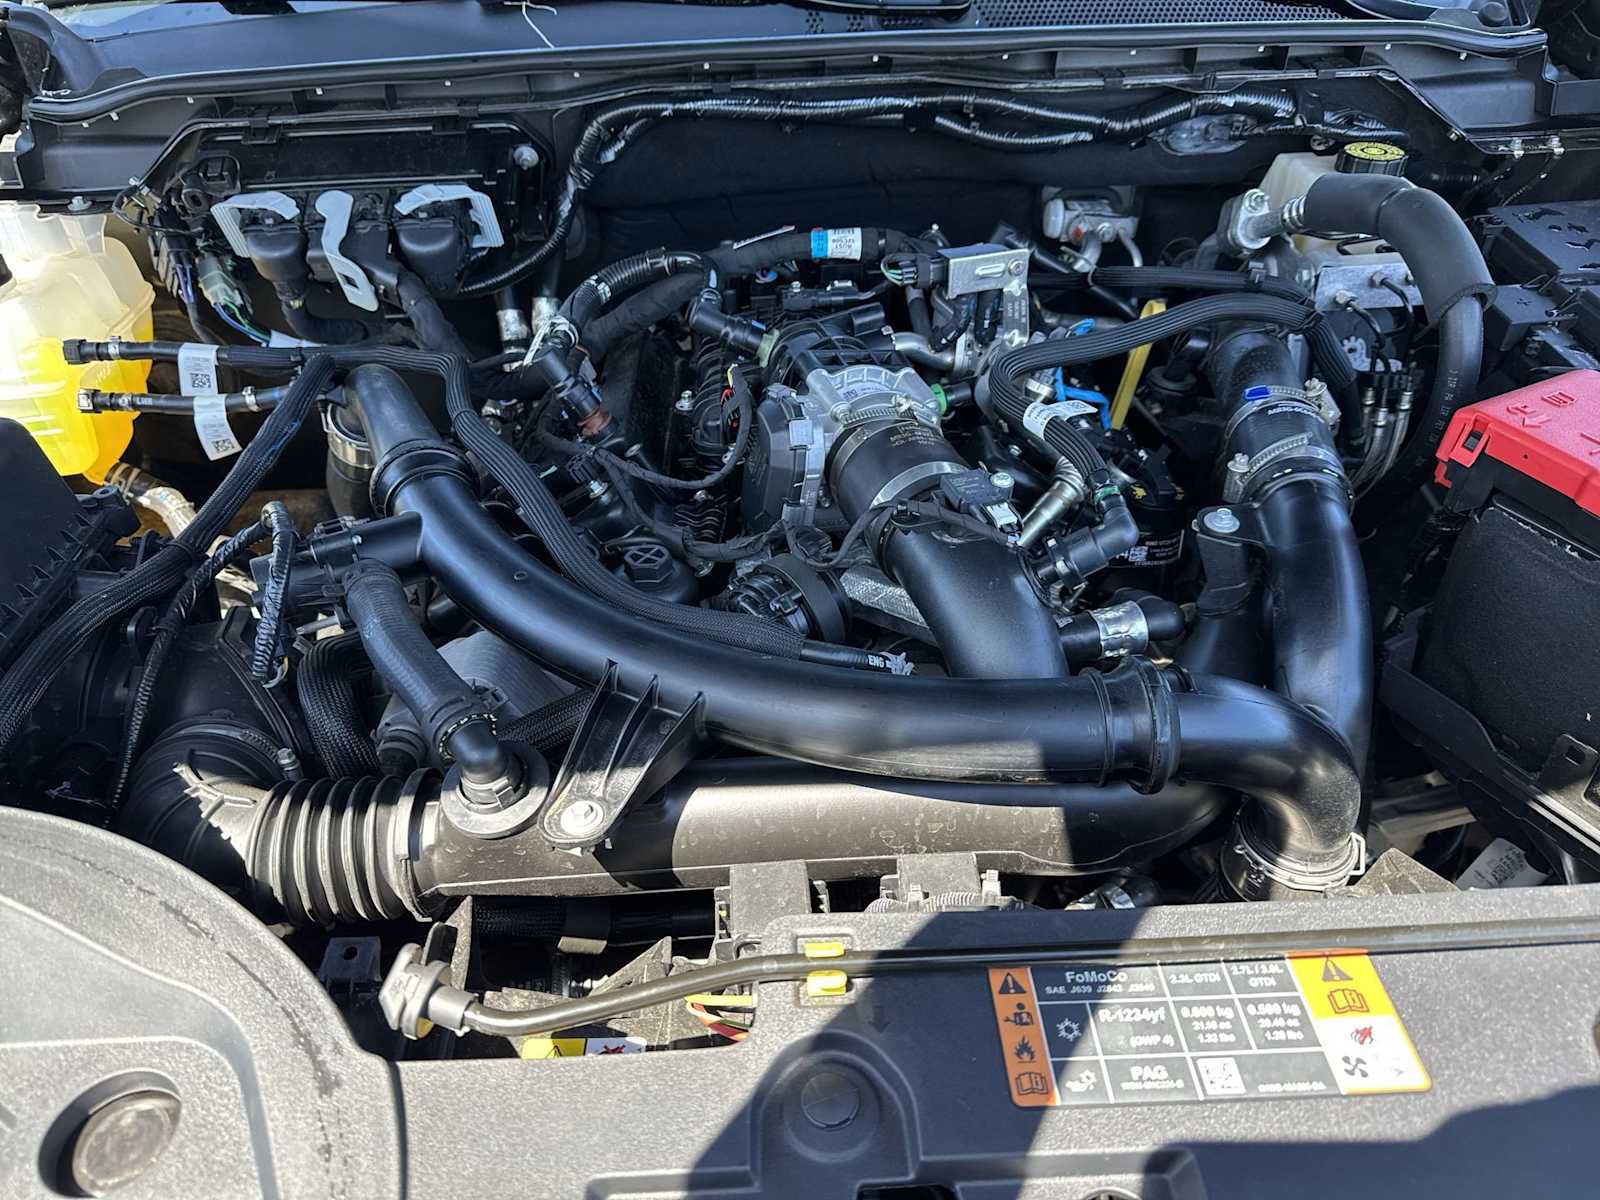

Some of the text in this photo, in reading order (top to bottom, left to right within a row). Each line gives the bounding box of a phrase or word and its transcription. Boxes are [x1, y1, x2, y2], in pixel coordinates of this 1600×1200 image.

[868, 654, 885, 668] ENG
[1064, 970, 1128, 983] FoMoCo
[1248, 977, 1277, 987] GTDI
[1045, 986, 1066, 994] SAE
[1070, 985, 1092, 993] J639
[1098, 1007, 1166, 1024] R-1234yf
[1130, 1065, 1168, 1081] PAG
